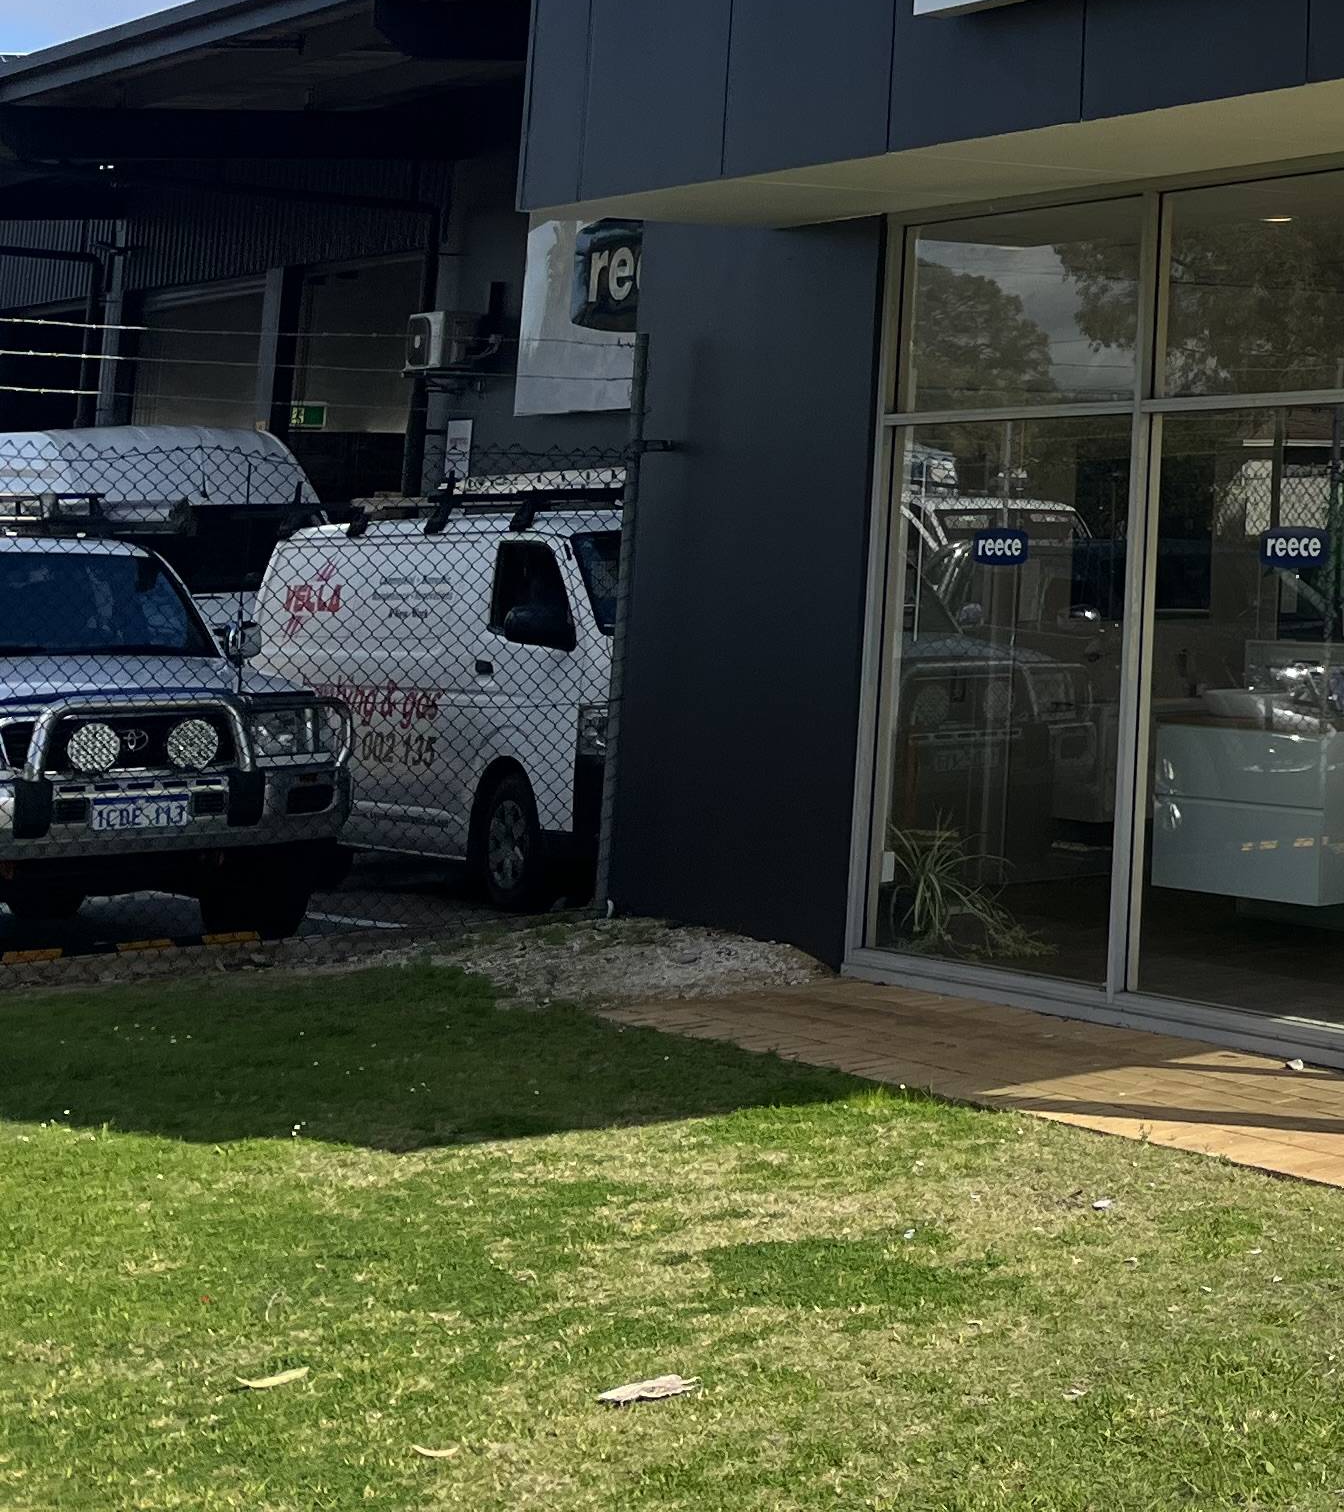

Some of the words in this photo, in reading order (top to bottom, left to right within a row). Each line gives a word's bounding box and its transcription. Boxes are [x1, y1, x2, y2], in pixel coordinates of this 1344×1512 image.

[588, 246, 642, 303] re
[977, 536, 1022, 558] reece
[1266, 534, 1322, 558] reece
